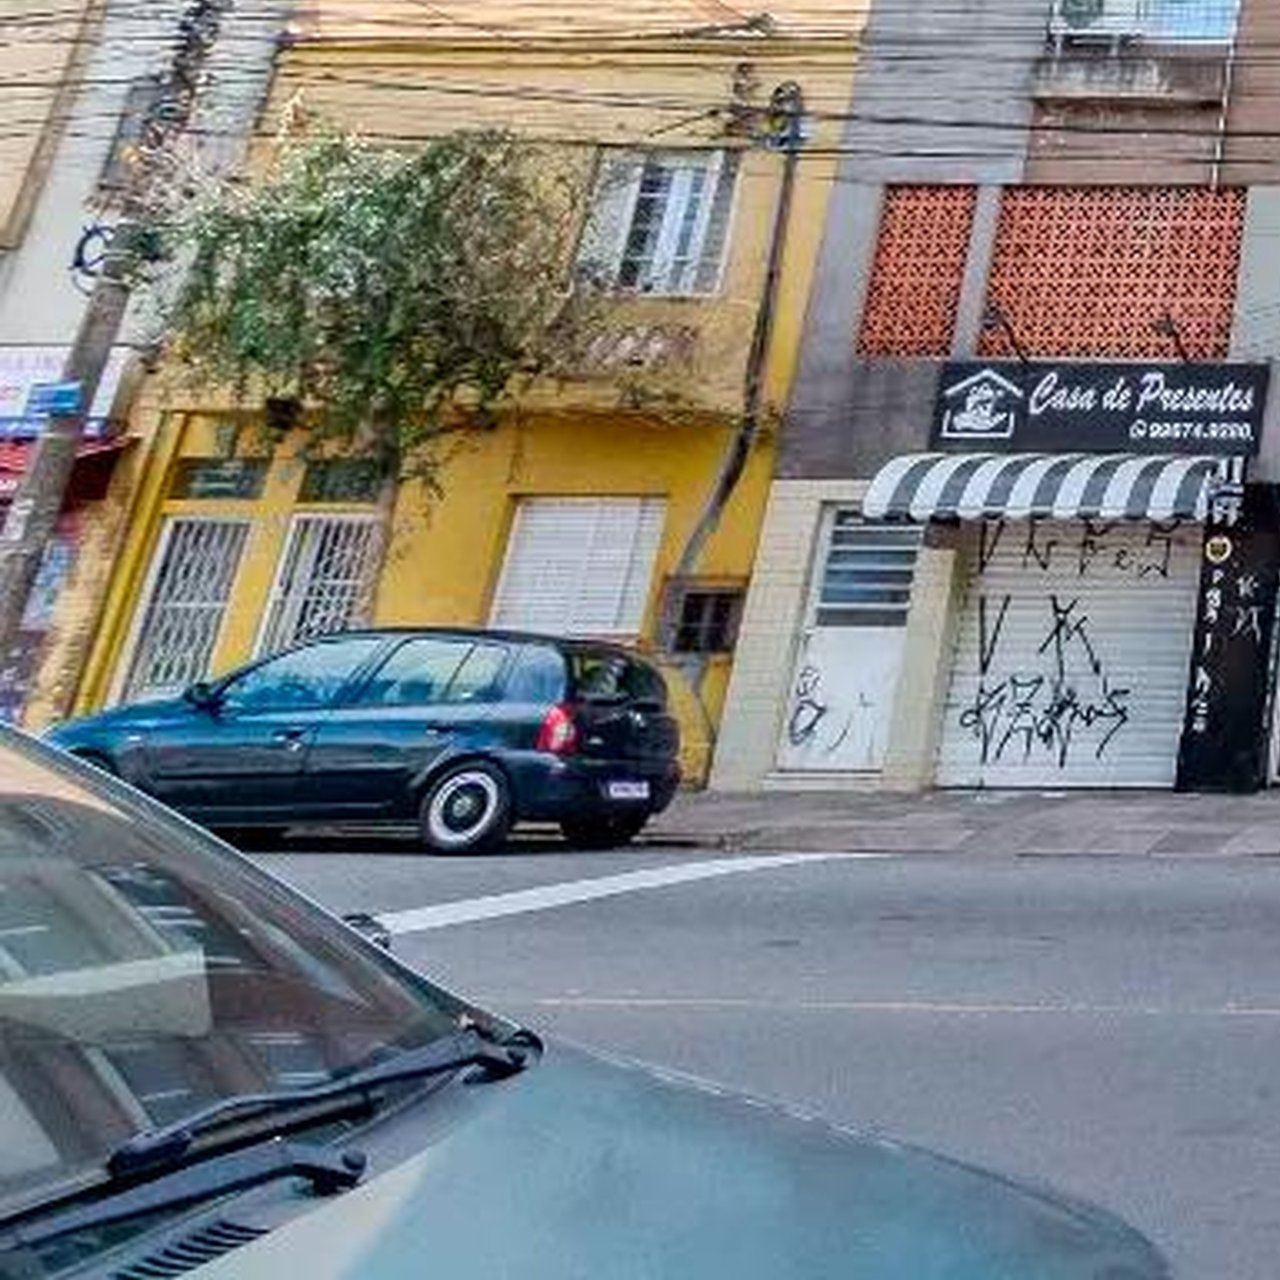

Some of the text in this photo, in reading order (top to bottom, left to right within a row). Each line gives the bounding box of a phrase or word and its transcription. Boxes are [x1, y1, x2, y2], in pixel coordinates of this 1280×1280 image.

[1028, 371, 1254, 415] Casa de Presentes
